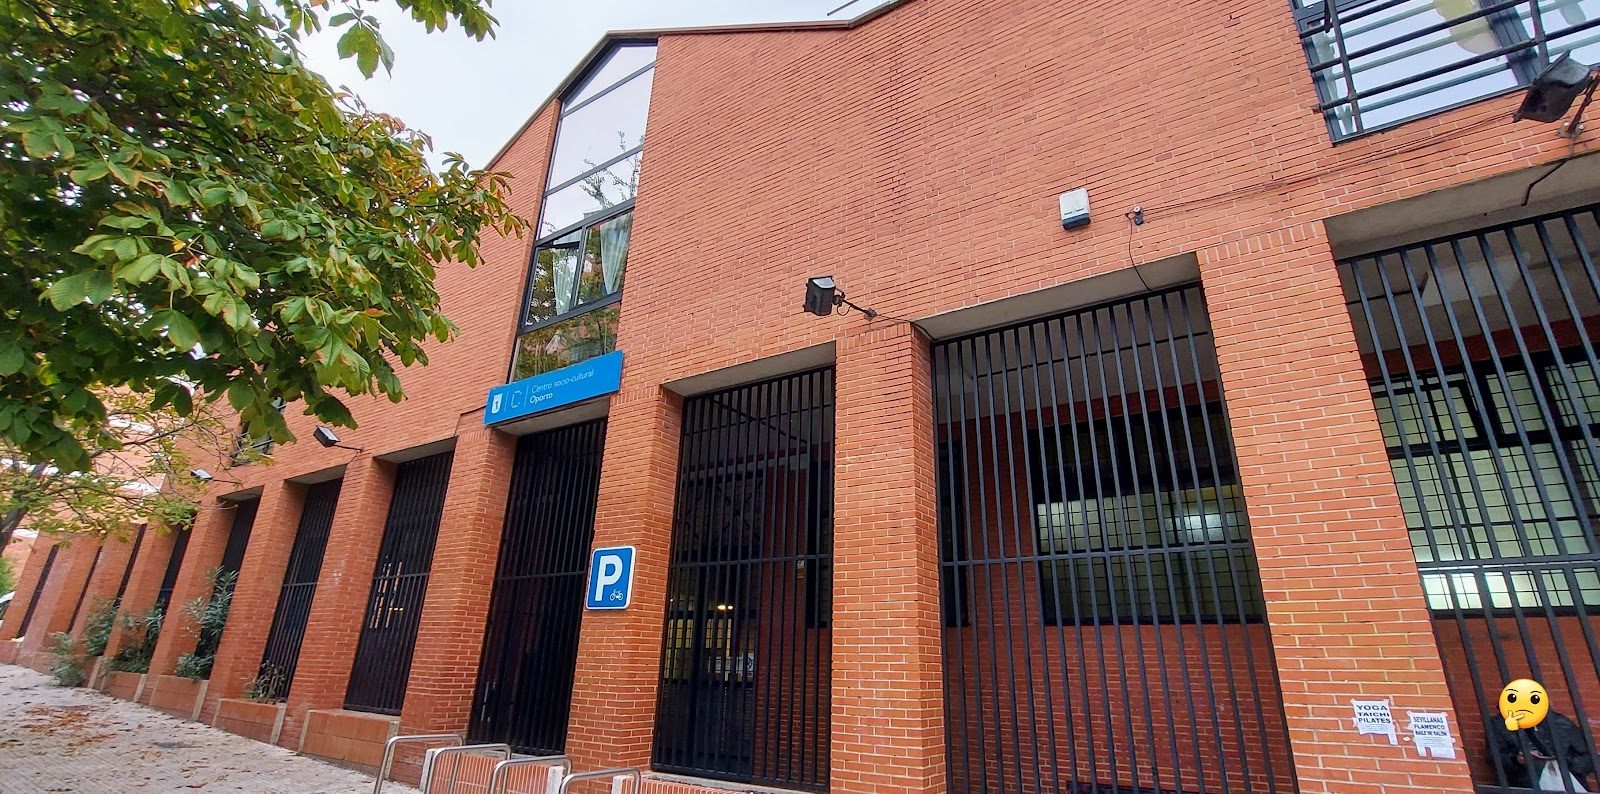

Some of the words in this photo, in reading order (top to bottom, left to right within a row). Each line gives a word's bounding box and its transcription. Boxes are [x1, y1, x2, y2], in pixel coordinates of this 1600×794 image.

[531, 383, 552, 394] Centro
[553, 368, 595, 388] socio-cultural
[529, 391, 553, 404] Oporto
[595, 555, 623, 601] P
